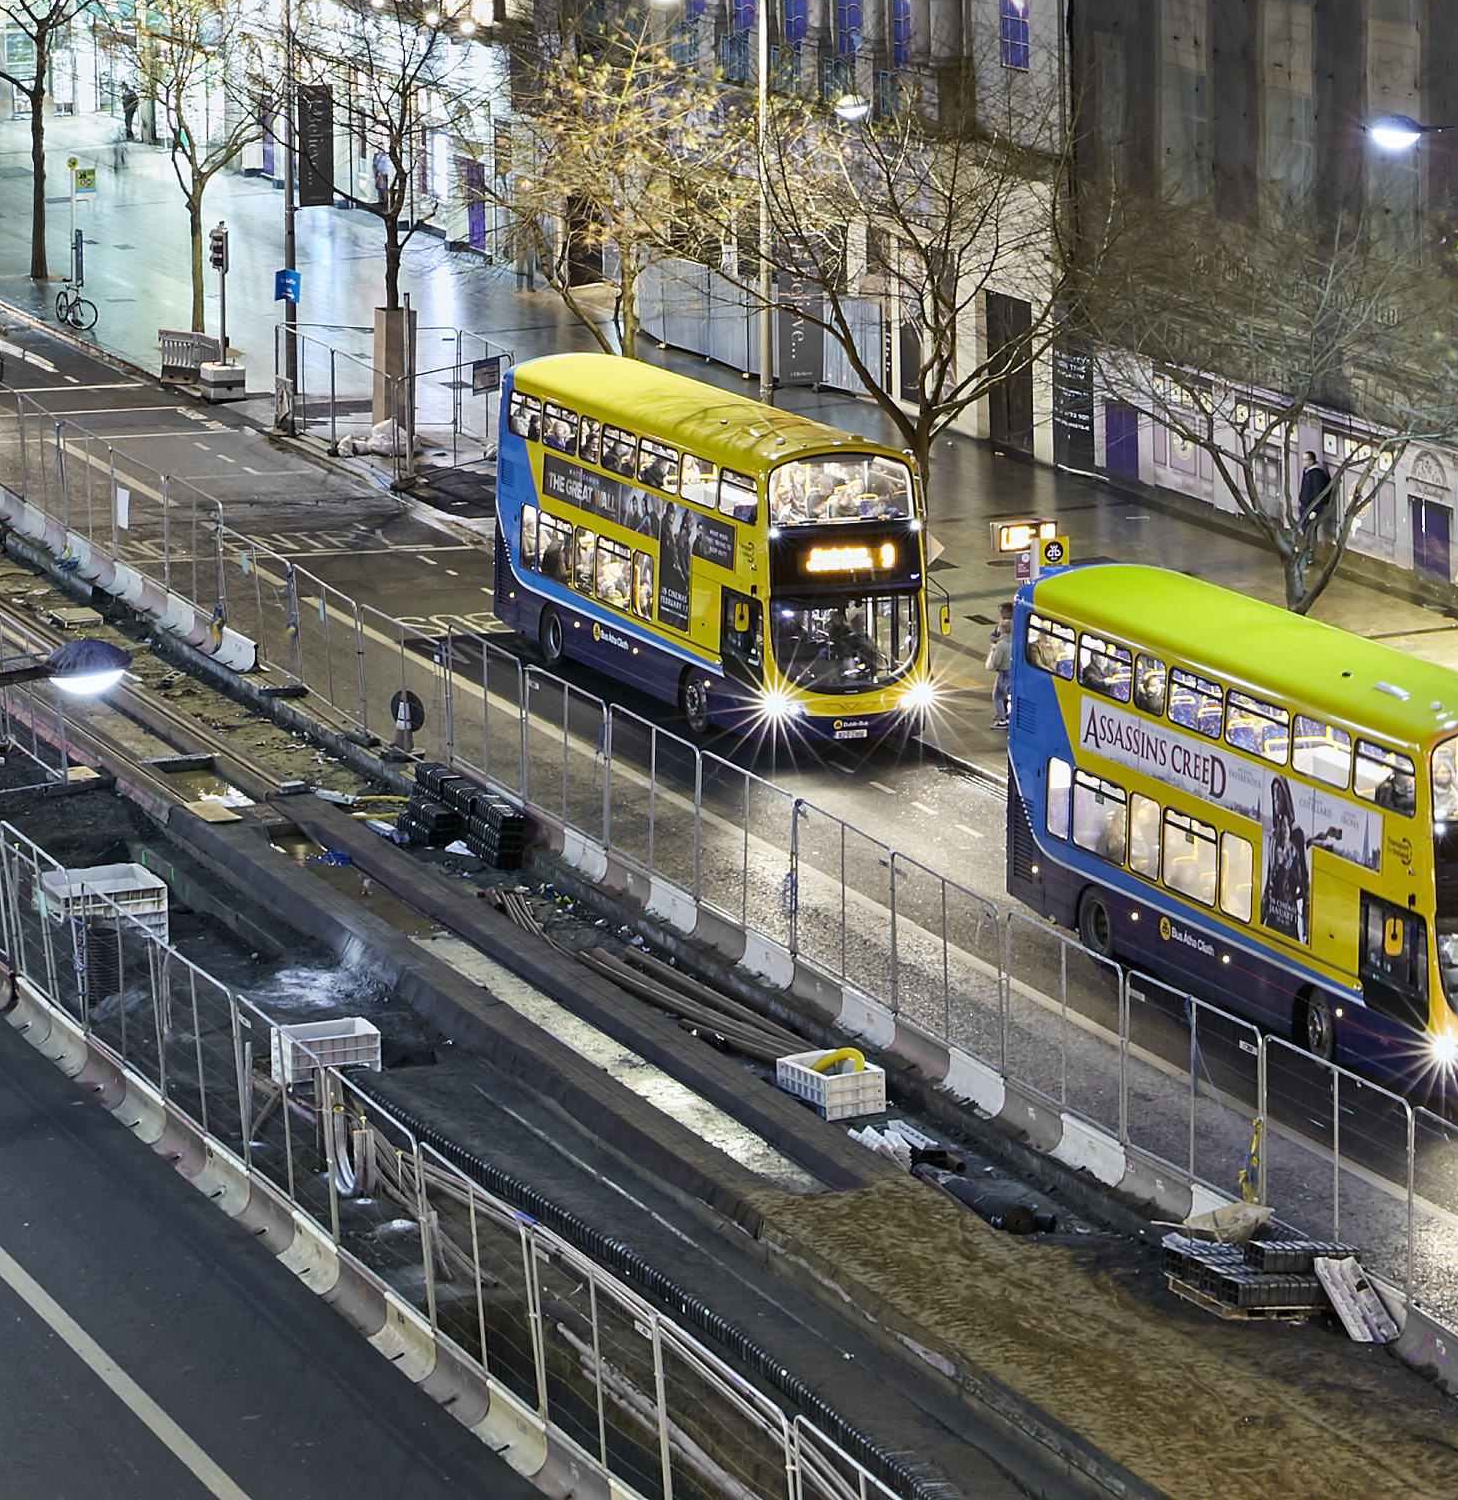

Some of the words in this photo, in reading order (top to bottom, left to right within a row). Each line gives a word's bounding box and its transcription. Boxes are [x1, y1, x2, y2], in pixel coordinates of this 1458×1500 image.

[549, 471, 565, 493] THE
[566, 479, 594, 504] GREAT
[594, 489, 617, 512] WALL
[1083, 705, 1168, 767] ASSASSINS
[1171, 744, 1227, 799] CREED
[1171, 927, 1183, 942] Bus
